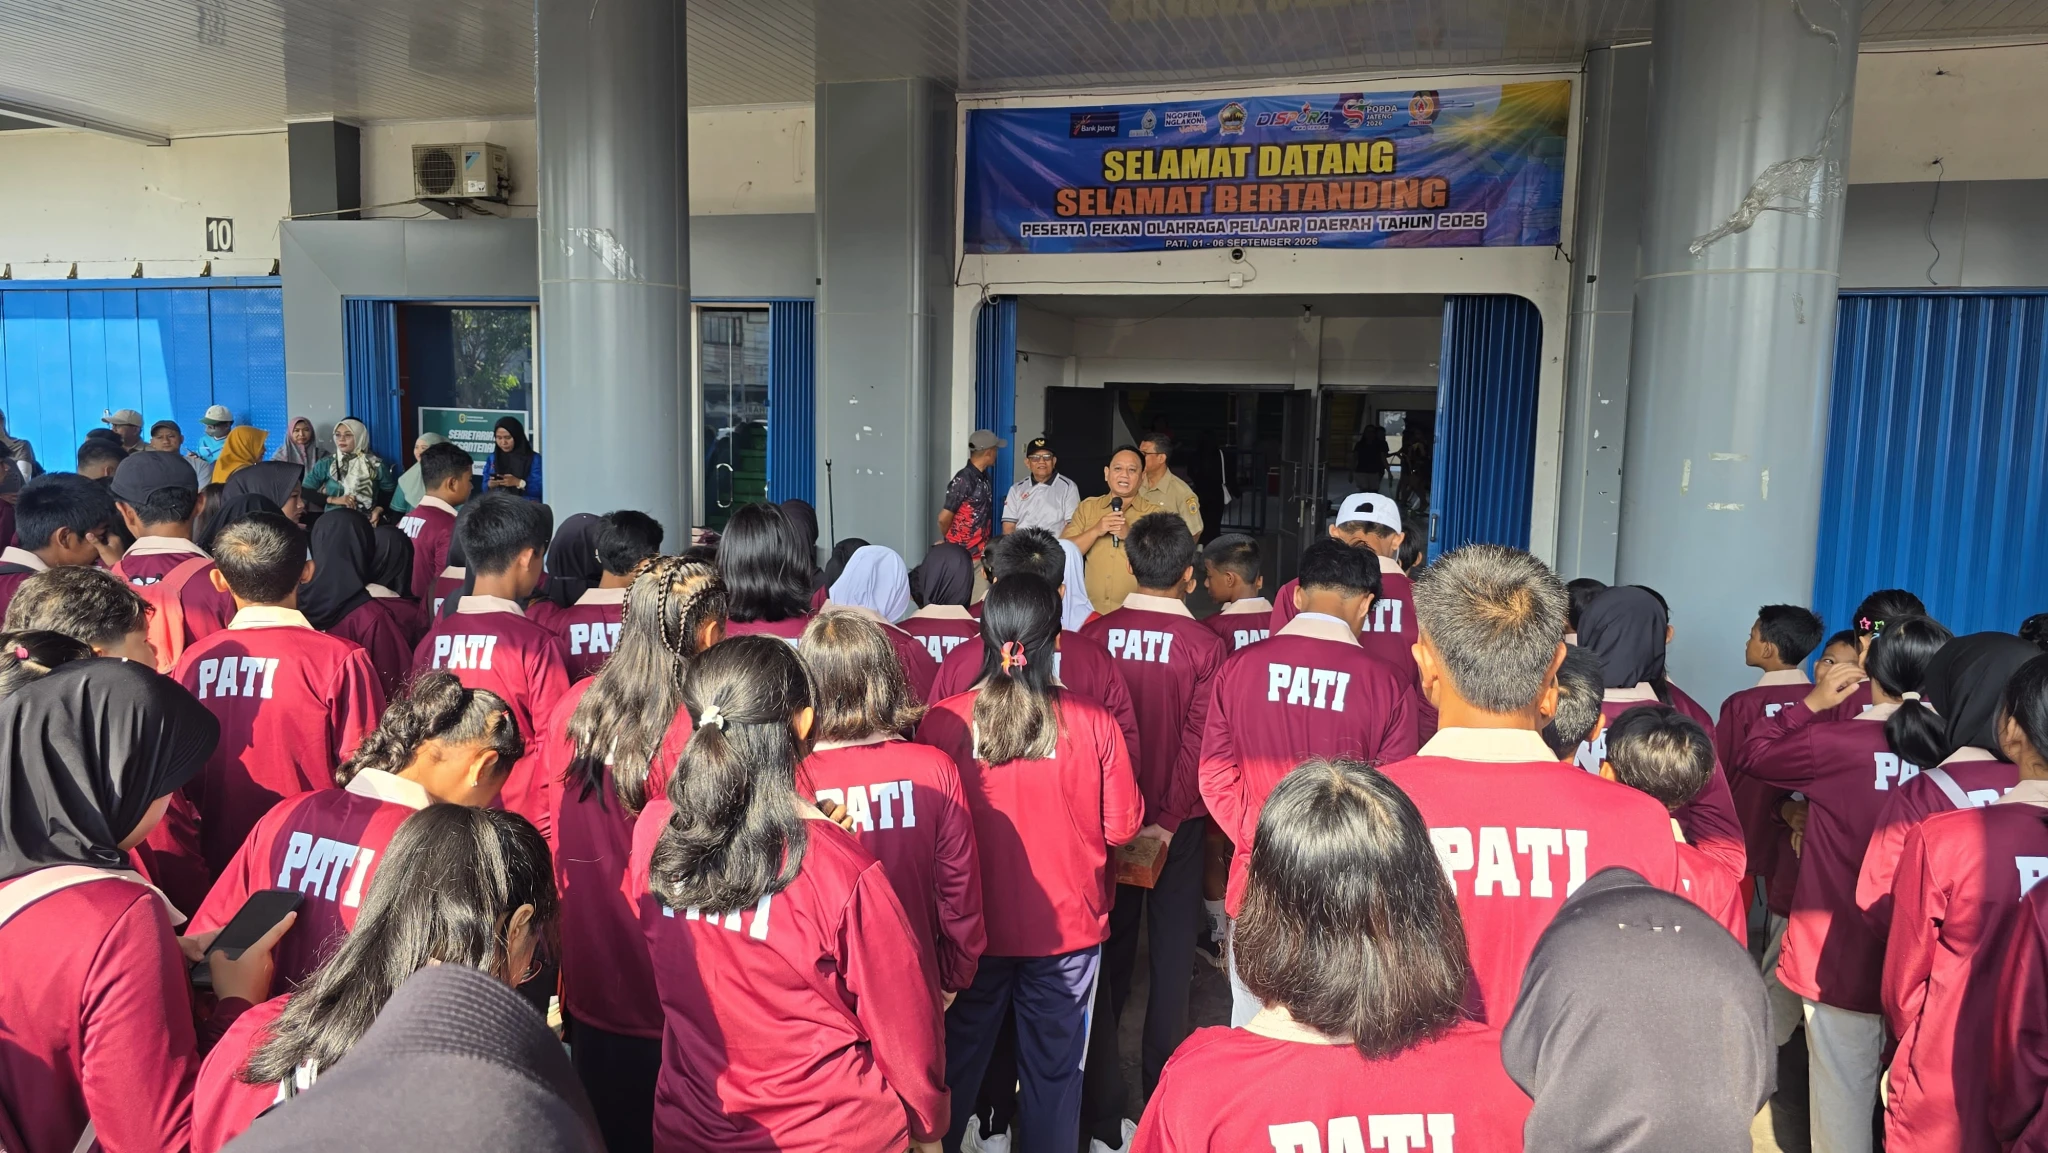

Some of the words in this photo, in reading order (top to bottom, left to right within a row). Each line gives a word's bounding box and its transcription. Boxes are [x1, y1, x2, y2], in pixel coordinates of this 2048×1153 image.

[1256, 110, 1331, 126] DISPORA
[1366, 105, 1398, 113] POPDA
[1081, 124, 1097, 132] Bank
[1097, 124, 1116, 133] Jateng
[1104, 147, 1251, 182] SELAMAT
[1258, 141, 1394, 177] DATANG
[1056, 186, 1207, 216] SELAMAT
[1214, 178, 1447, 213] BERTANDING
[208, 220, 232, 250] 10
[1021, 222, 1087, 237] PESERTA
[1090, 221, 1142, 236] PEKAN
[1146, 219, 1227, 236] OLAHRAGA
[1229, 217, 1301, 234] PELAJAR
[1305, 215, 1373, 233] DAERAH
[1377, 213, 1434, 231] TAHUN
[1437, 212, 1487, 230] 2026
[1192, 239, 1203, 247] 01
[1212, 239, 1224, 247] 06
[1226, 237, 1291, 247] SEPTEMBER
[1294, 237, 1318, 246] 2026
[448, 429, 495, 442] SEKRETARIA
[398, 516, 426, 539] PATI
[432, 634, 498, 670] PATI
[570, 622, 623, 655] PAT
[1107, 628, 1174, 664] PATI
[199, 656, 280, 699] PATI
[1267, 662, 1351, 712] PATI
[276, 831, 376, 908] PATI
[1429, 827, 1588, 898] PATI
